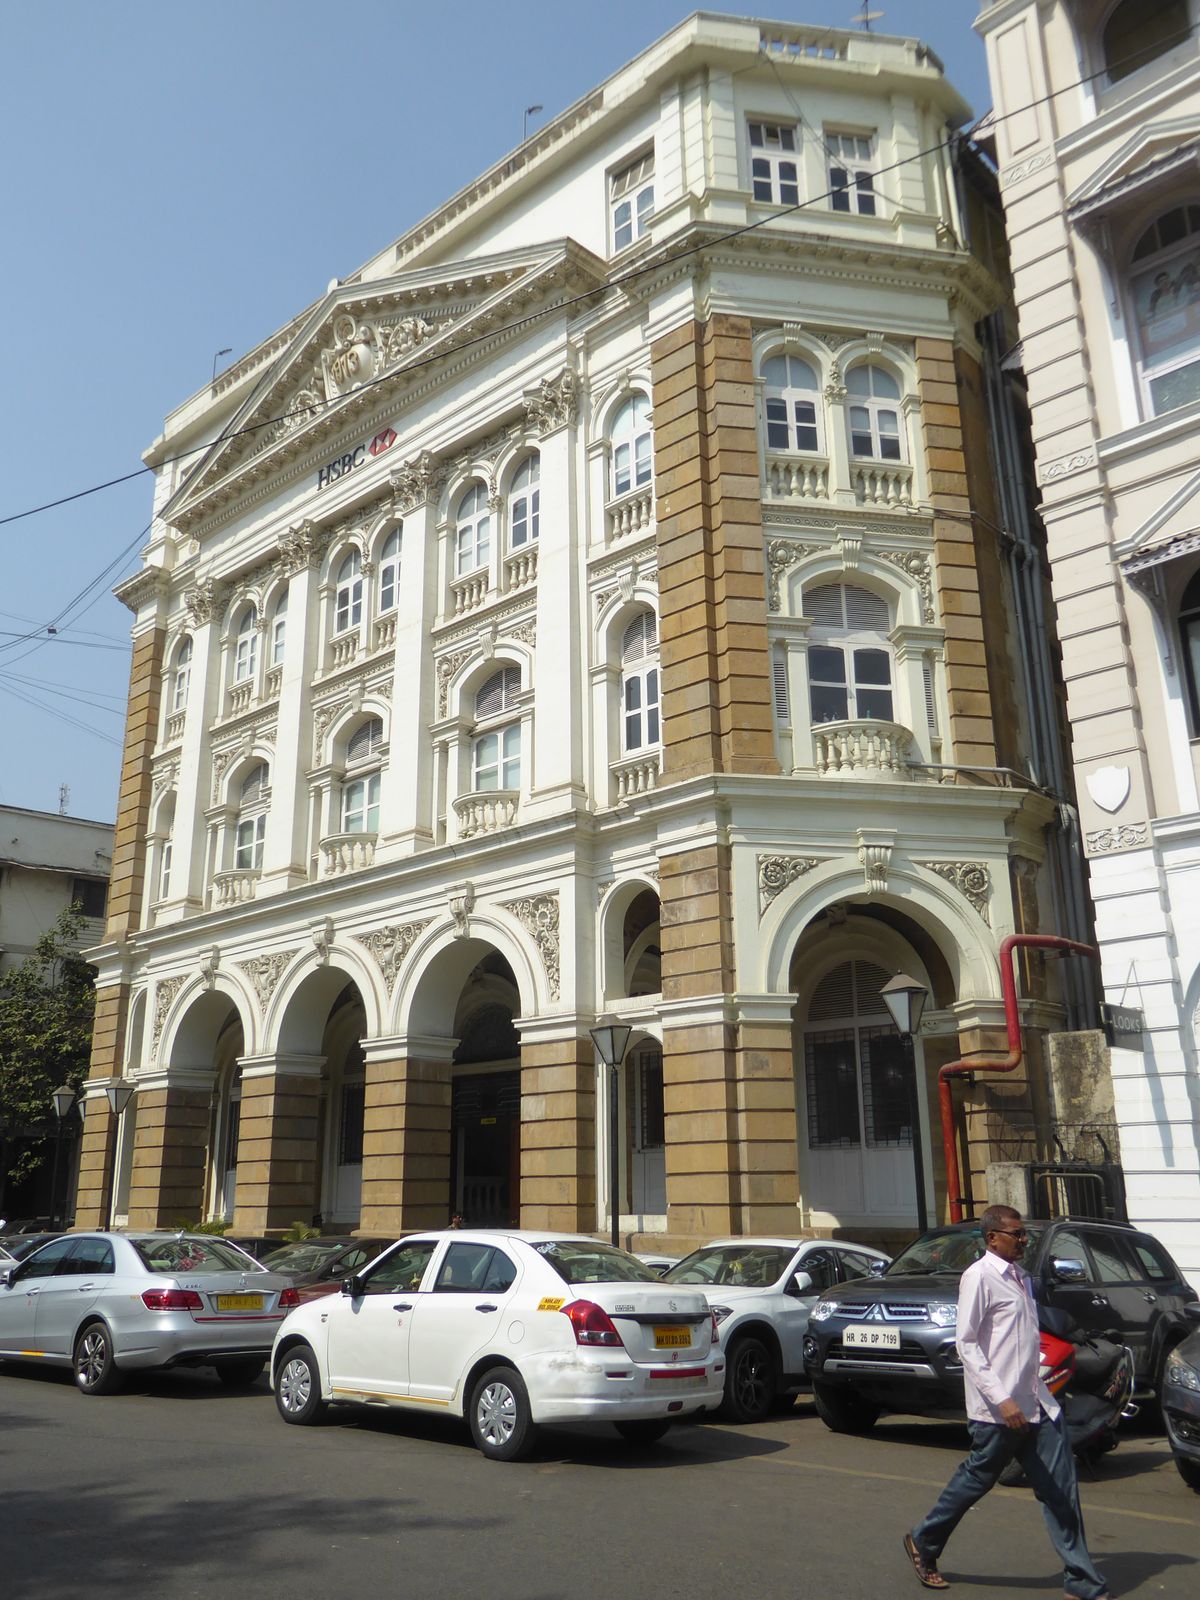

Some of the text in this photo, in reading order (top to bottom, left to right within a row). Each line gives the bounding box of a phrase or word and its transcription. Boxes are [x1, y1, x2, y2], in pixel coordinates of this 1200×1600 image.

[316, 444, 366, 491] HSBC
[1112, 1014, 1141, 1033] LOOKS
[846, 1332, 897, 1345] HR 26 DP 7199
